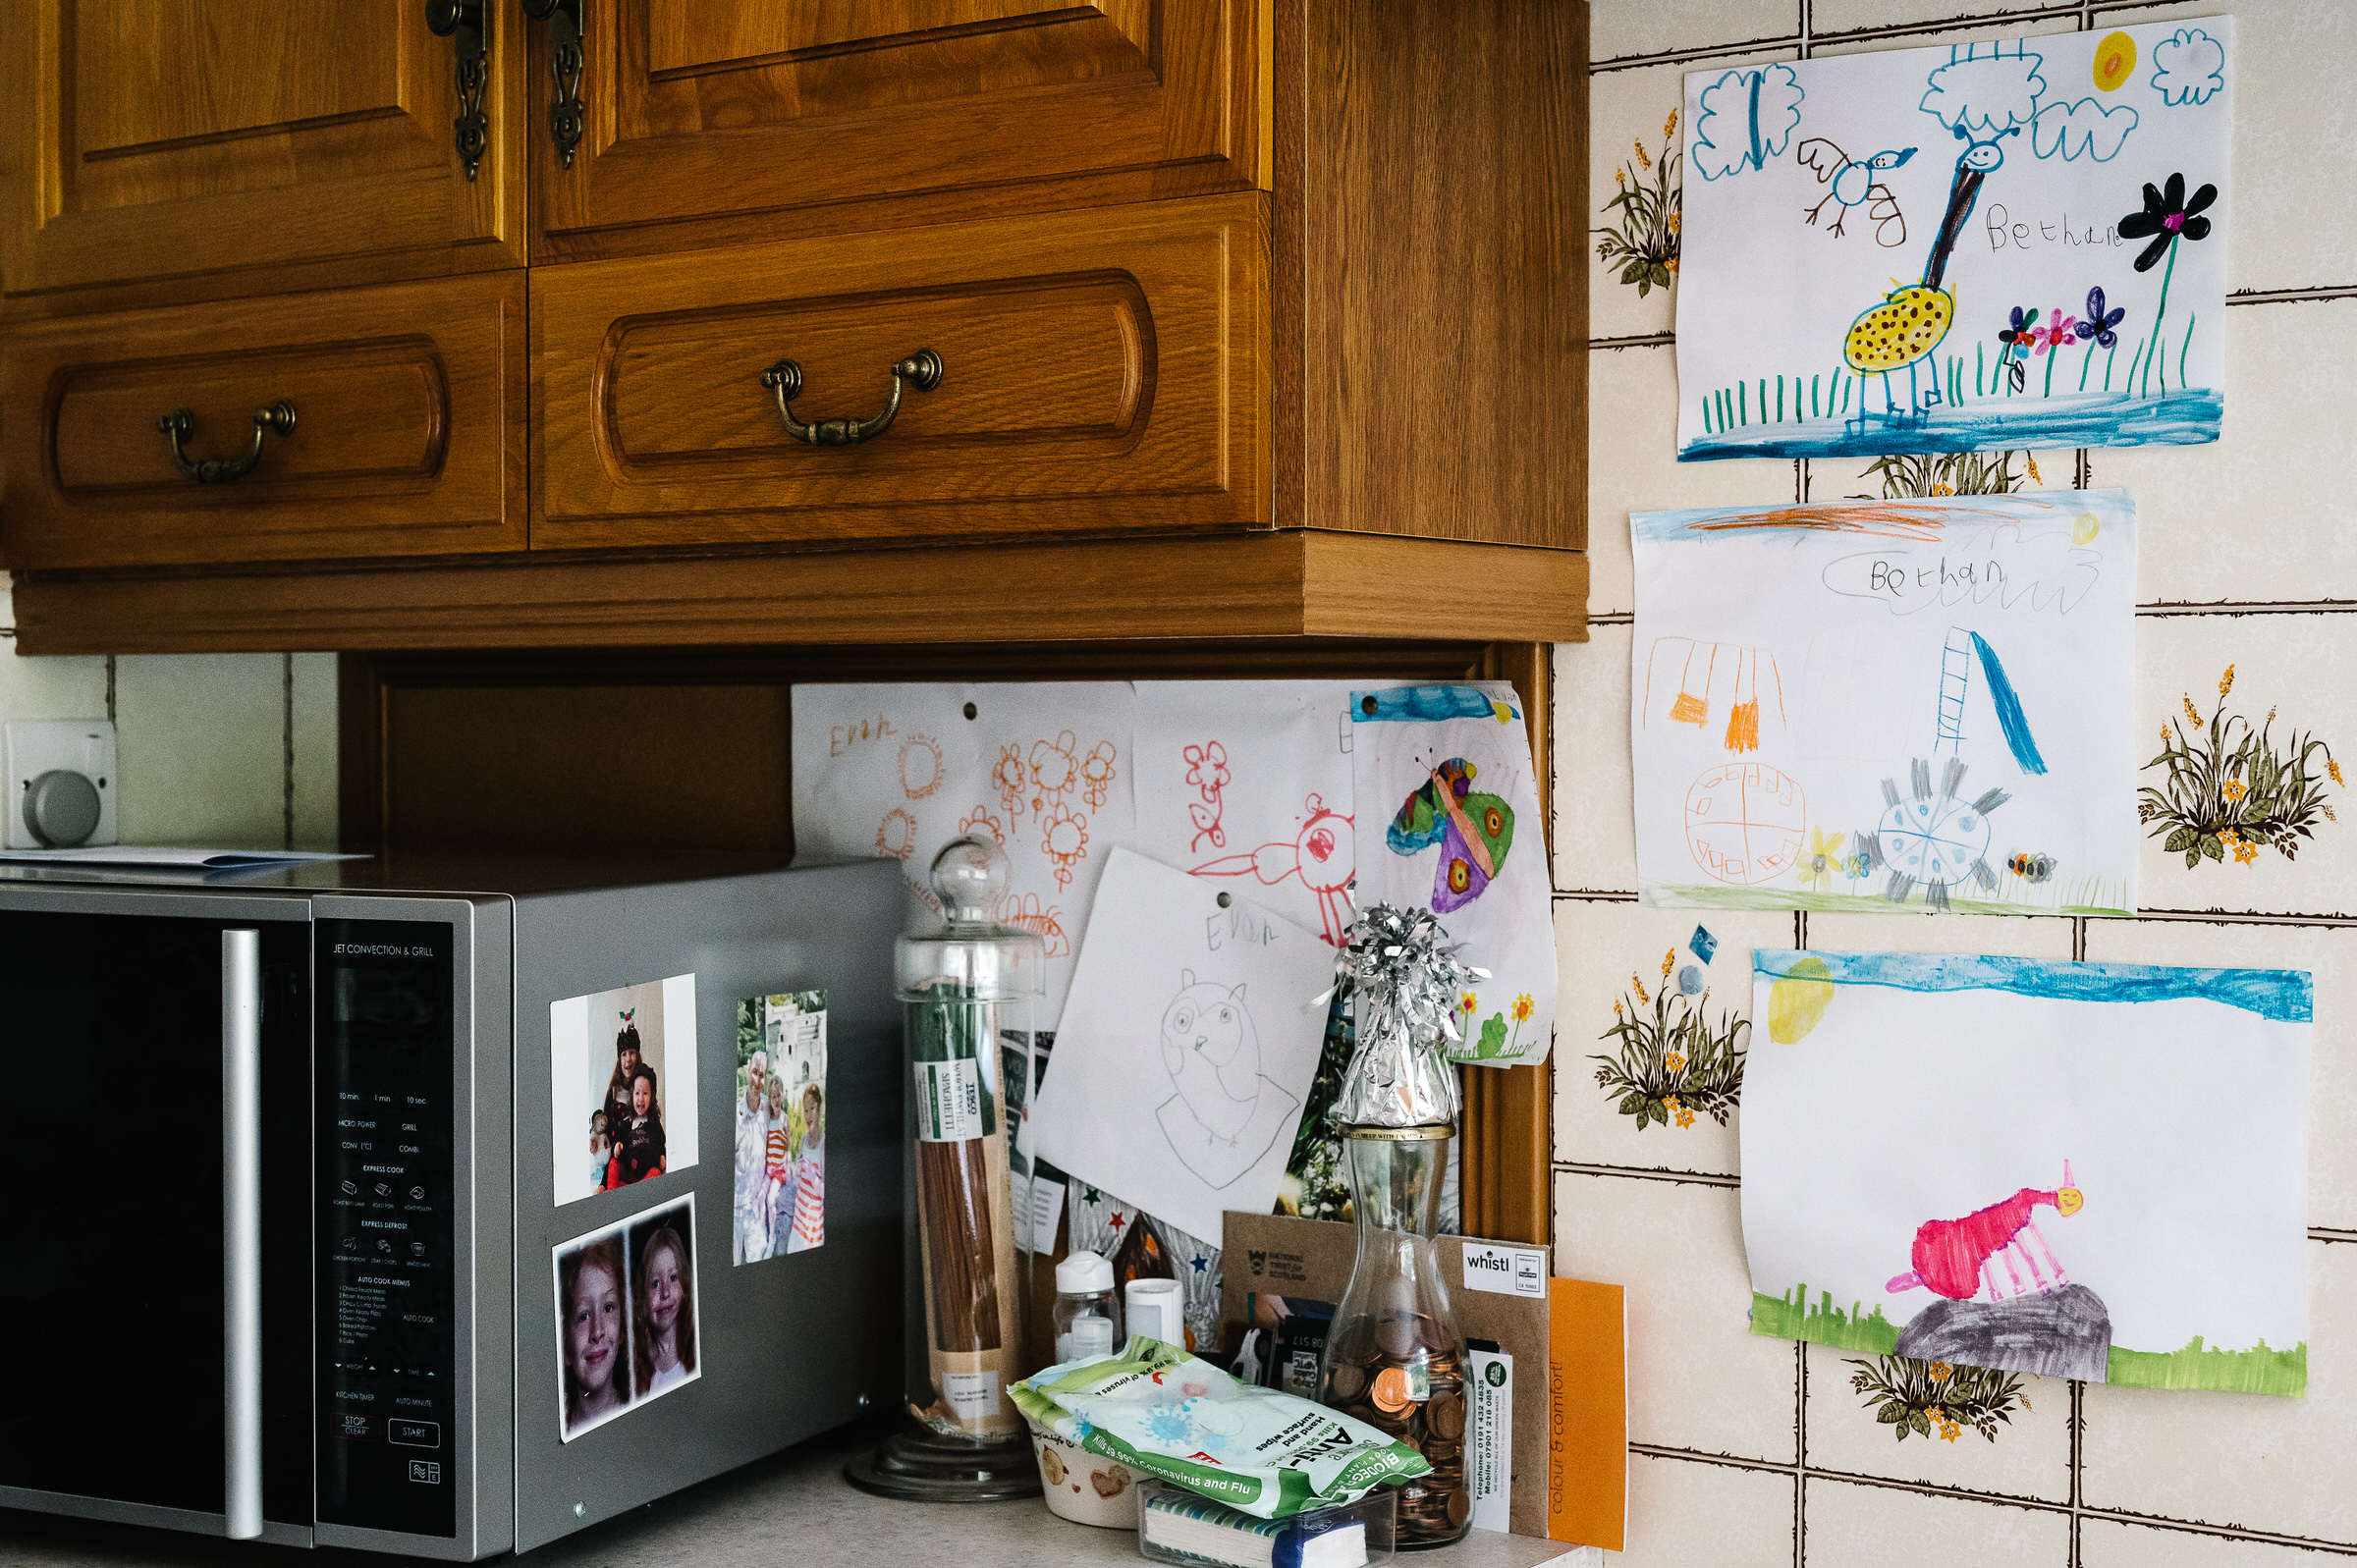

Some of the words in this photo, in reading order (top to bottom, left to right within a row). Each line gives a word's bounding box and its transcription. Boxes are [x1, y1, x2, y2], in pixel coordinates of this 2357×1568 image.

[1986, 203, 2123, 253] Bethan
[1870, 556, 2005, 597] Bethan
[333, 944, 346, 953] JET
[347, 945, 402, 955] CONVECTION
[403, 946, 410, 956] &
[411, 946, 434, 957] GRILL
[407, 1096, 414, 1105] 10
[941, 1072, 955, 1130] SPAGHETTI
[965, 1082, 978, 1115] TESCO
[356, 1120, 376, 1129] POWER
[401, 1123, 417, 1132] GRILL
[362, 1164, 386, 1173] EXPRESS
[386, 1165, 405, 1174] COOK
[360, 1219, 384, 1228] EXPRESS
[384, 1221, 408, 1230] DEFROST
[1467, 1250, 1509, 1272] whistl
[391, 1278, 411, 1287] MENUS
[403, 1314, 417, 1323] AUTO
[417, 1315, 434, 1324] COOK
[1101, 1376, 1130, 1393] viruses
[1130, 1374, 1139, 1382] of
[335, 1391, 358, 1400] KITCHEN
[358, 1392, 375, 1402] TIMER
[395, 1397, 411, 1406] AUTO
[411, 1398, 432, 1408] MINUTE
[1549, 1361, 1563, 1435] comfort!
[345, 1415, 366, 1426] STOP
[1283, 1411, 1316, 1435] surface
[1303, 1415, 1327, 1435] Hand
[345, 1427, 366, 1435] CLEAR
[402, 1427, 426, 1437] START
[1317, 1421, 1339, 1437] Kills
[1255, 1433, 1284, 1453] wipes
[1282, 1434, 1301, 1448] and
[1550, 1439, 1563, 1453] &
[1092, 1433, 1107, 1451] Kills
[1138, 1459, 1201, 1487] Coronavirus
[1203, 1479, 1228, 1491] and
[1230, 1482, 1252, 1495] Flu
[1338, 1451, 1400, 1491] BIODEGR
[1343, 1458, 1368, 1479] PLANT
[1549, 1456, 1563, 1514] colour
